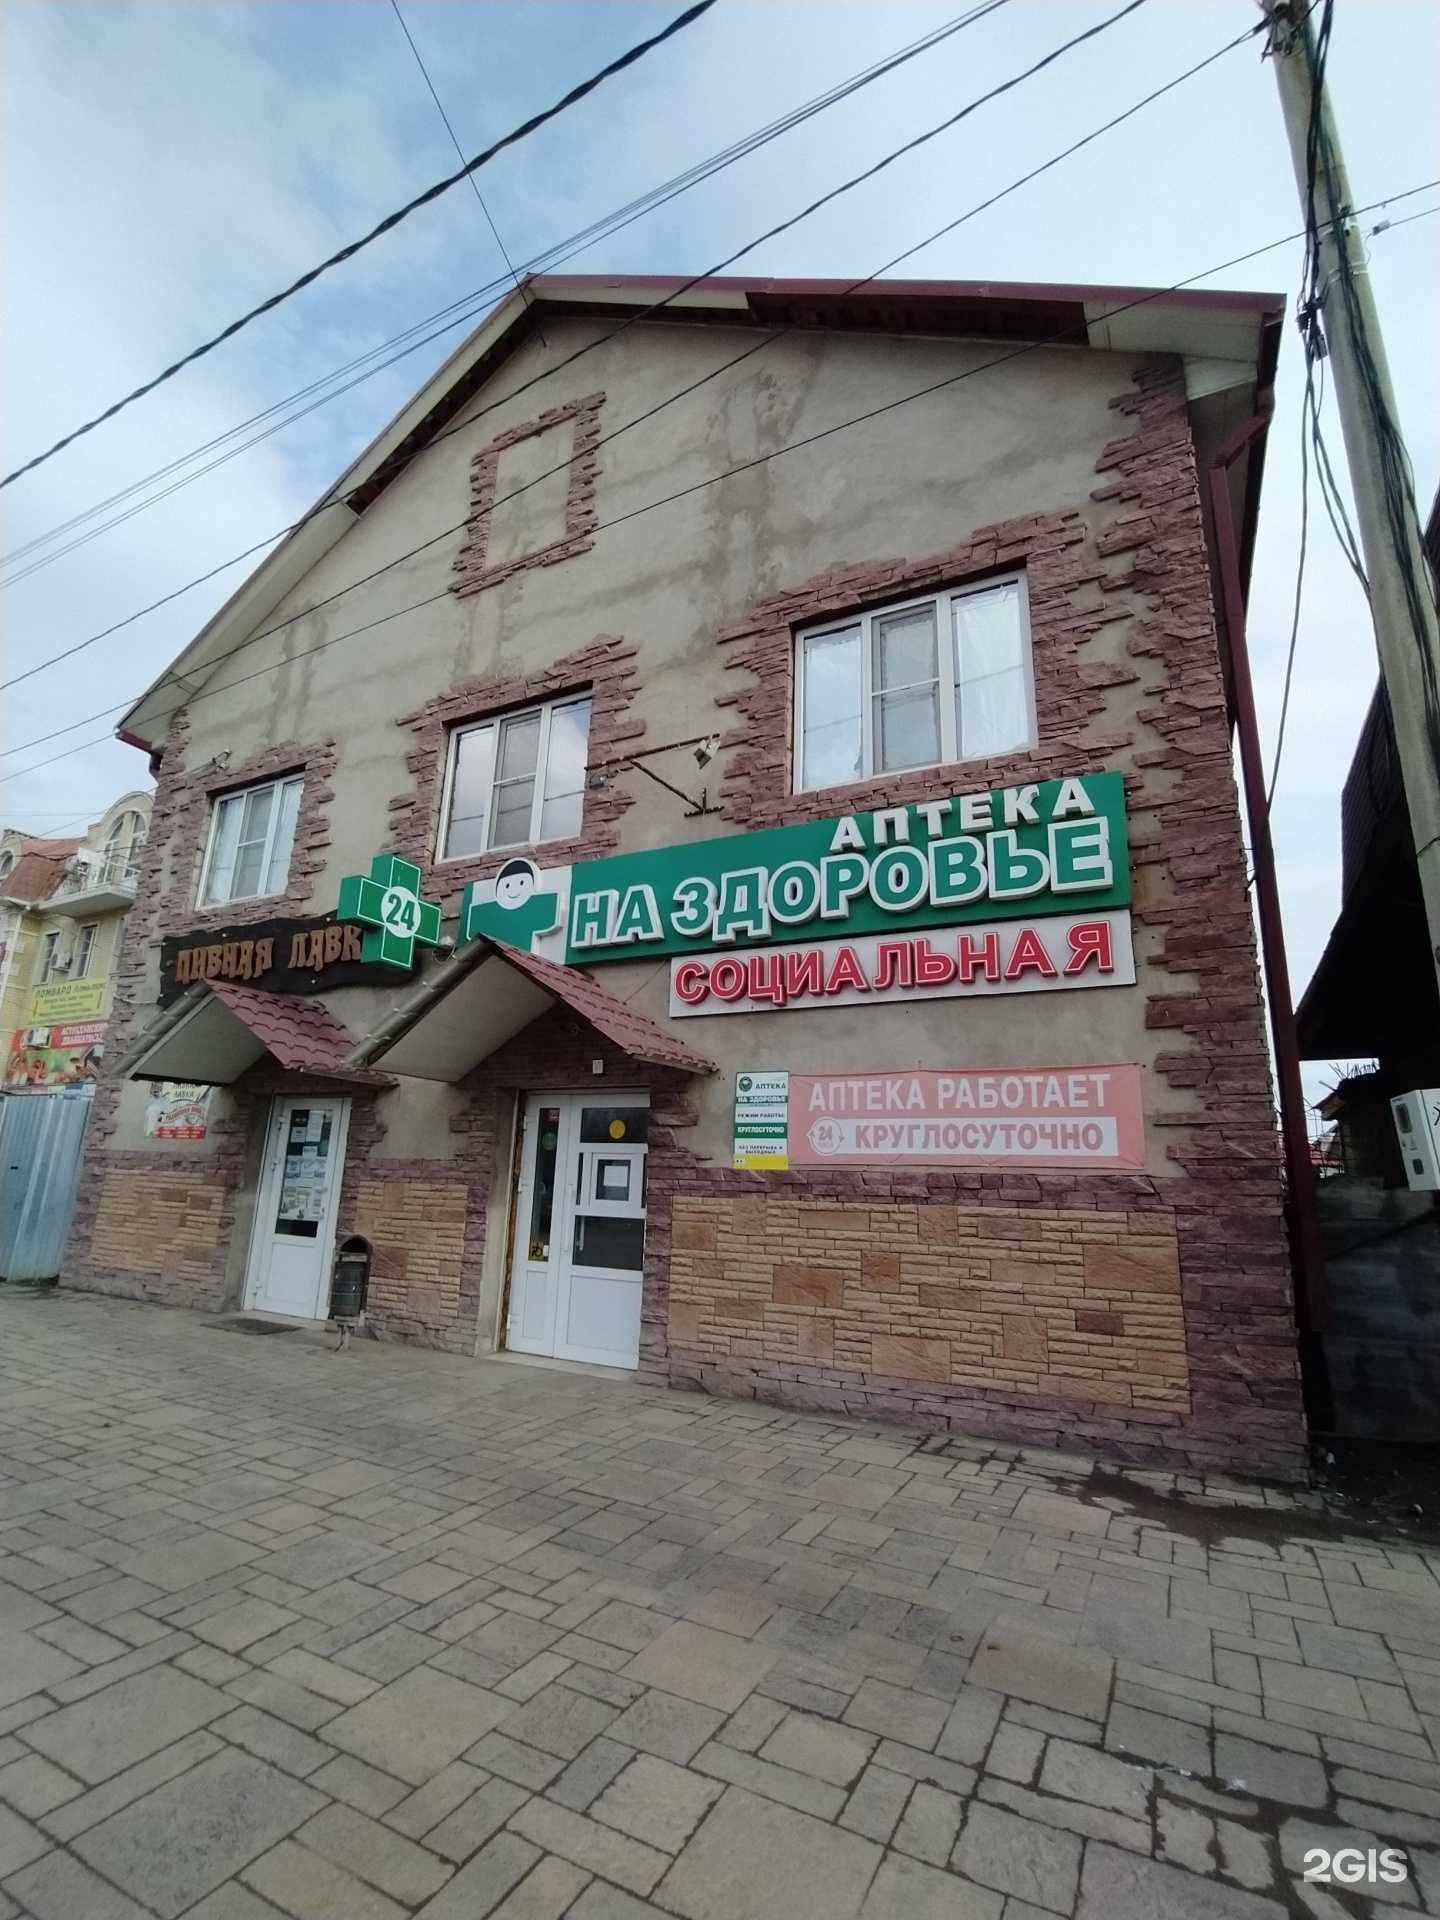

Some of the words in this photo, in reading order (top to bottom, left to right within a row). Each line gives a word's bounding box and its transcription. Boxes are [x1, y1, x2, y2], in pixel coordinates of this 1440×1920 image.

[830, 778, 1095, 850] АПТЕКА
[570, 884, 664, 949] НА
[670, 816, 1114, 943] ЗДОРОВЬЕ
[386, 894, 415, 931] 24
[175, 937, 274, 984] ПИВНАЯ
[674, 919, 1114, 1006] СОЦИАЛЬНАЯ
[809, 1079, 926, 1112] АПТЕКА
[938, 1074, 1111, 1111] РАБОТАЕТ
[737, 1126, 785, 1134] КРУГЛОСУТОЧНО
[818, 1126, 834, 1140] 24
[855, 1122, 1103, 1150] КРУГЛОСУТОЧНО
